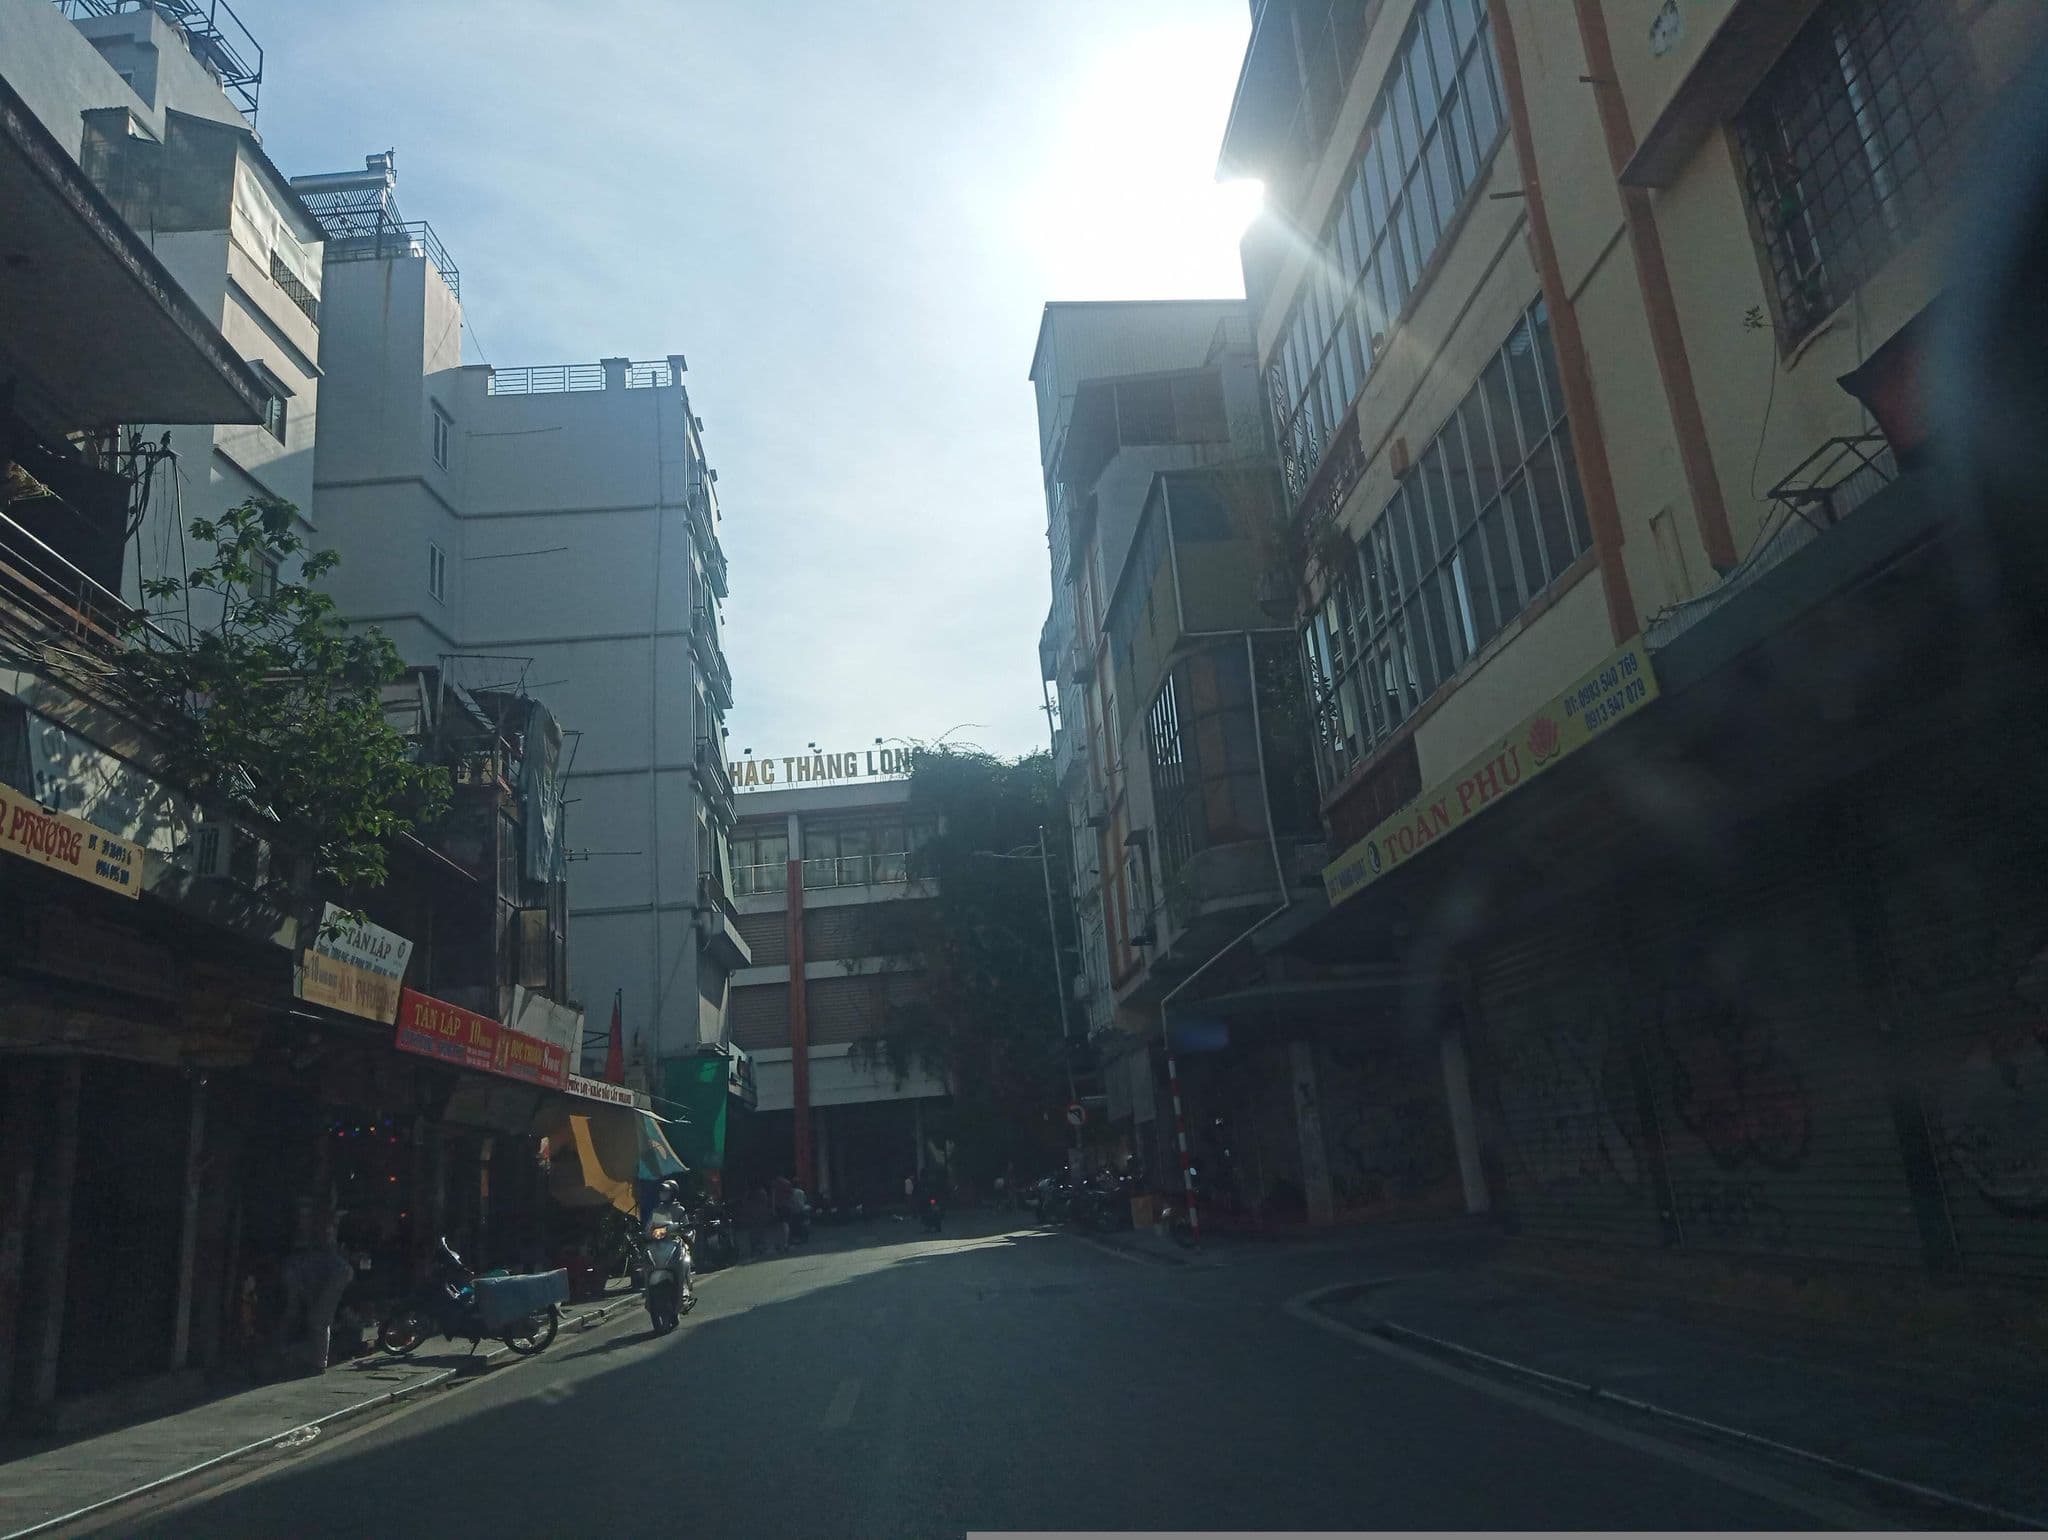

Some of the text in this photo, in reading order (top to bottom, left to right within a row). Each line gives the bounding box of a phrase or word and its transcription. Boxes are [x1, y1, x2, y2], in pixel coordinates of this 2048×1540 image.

[783, 749, 858, 783] THĂNG
[1383, 739, 1521, 864] TOÀN PHÚ
[370, 937, 392, 962] LẬP
[416, 1002, 437, 1031] TÂN
[440, 1010, 462, 1040] LẬP
